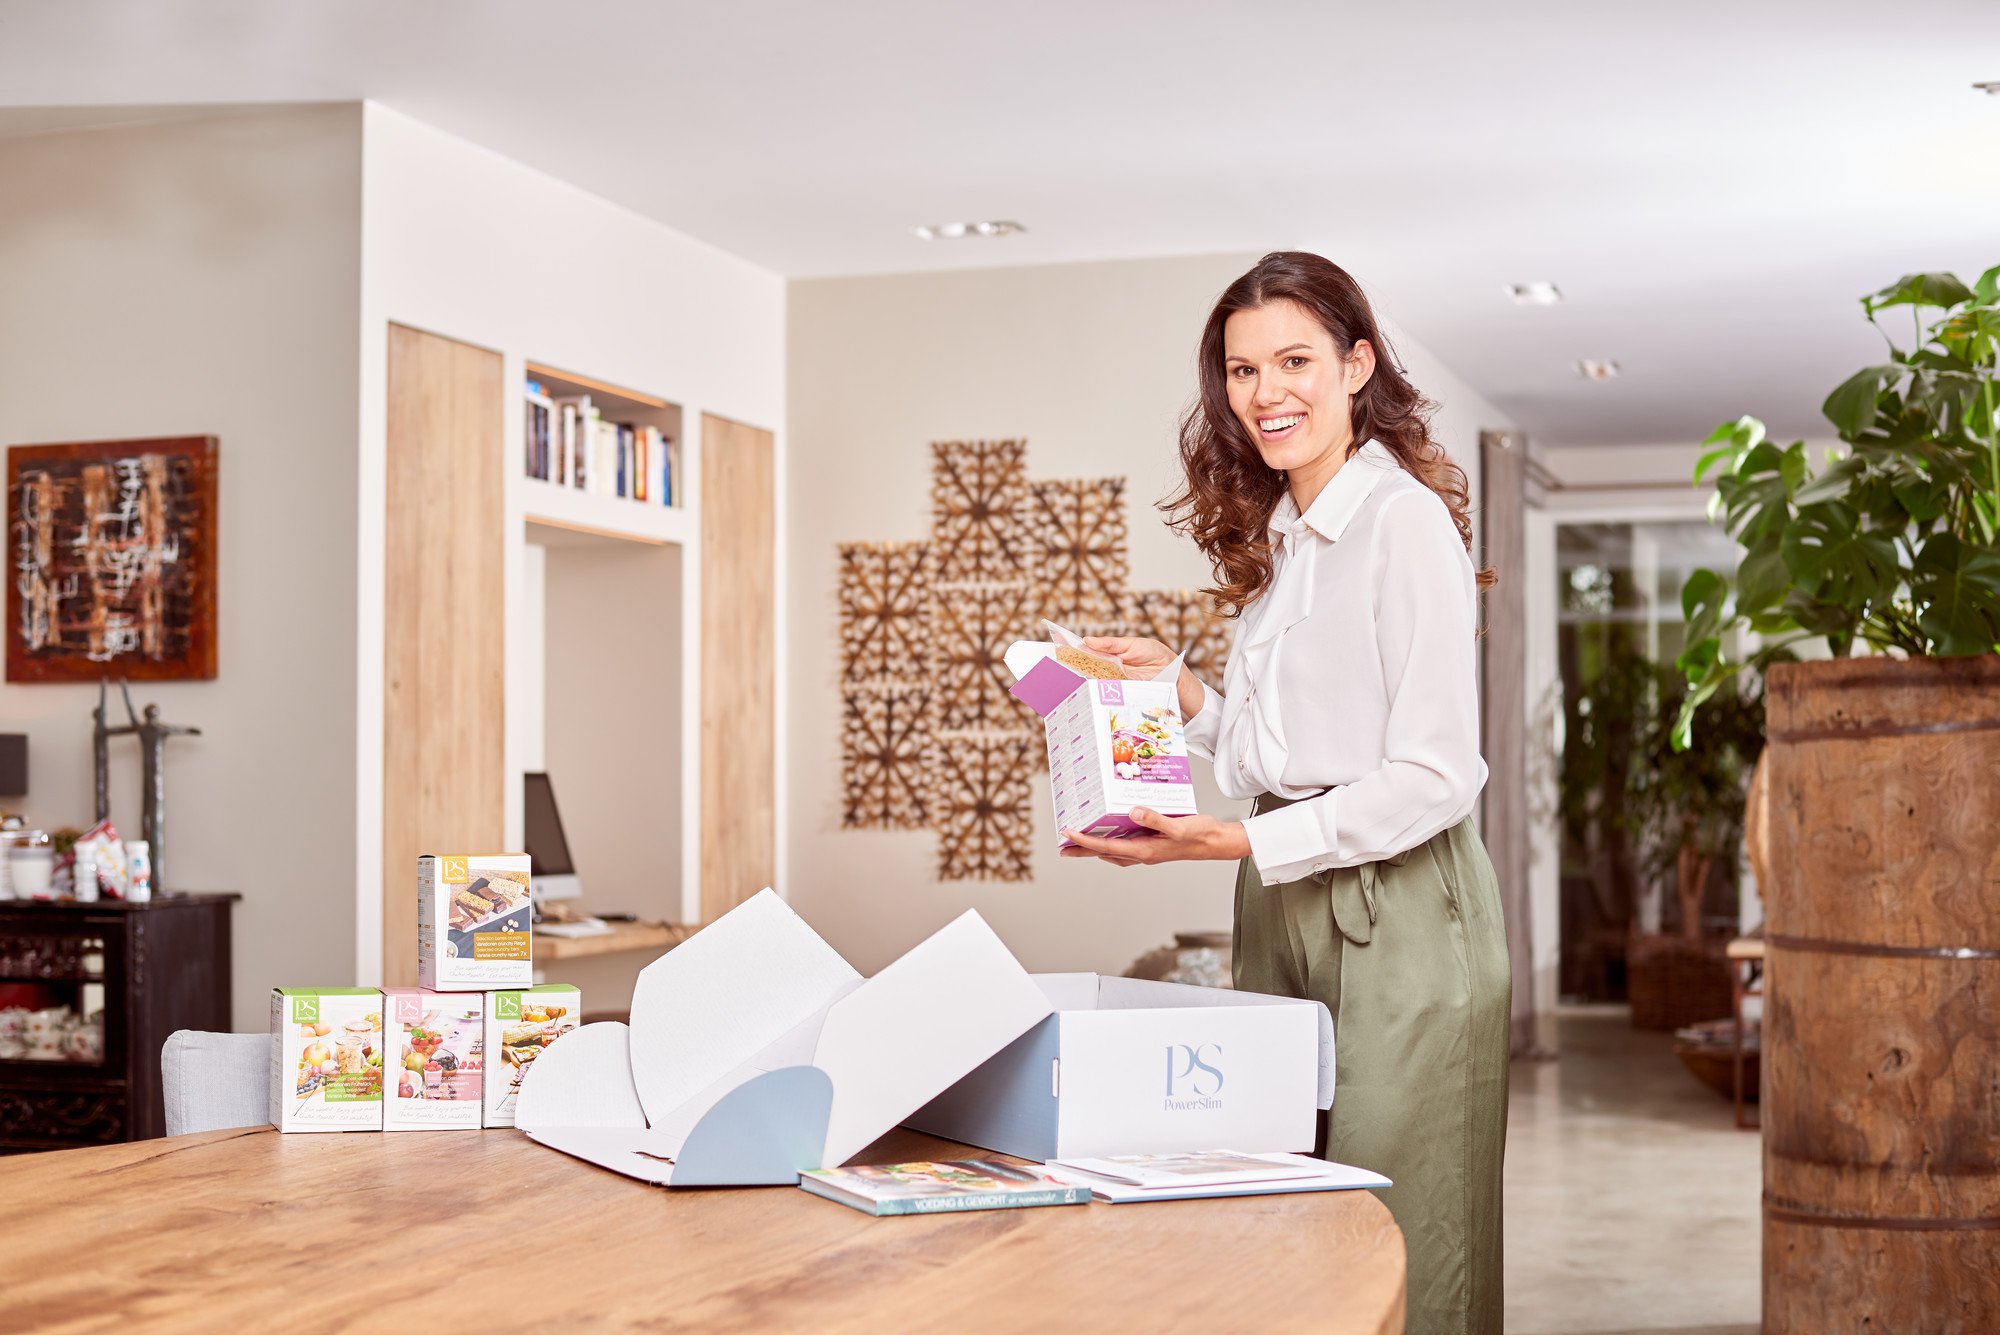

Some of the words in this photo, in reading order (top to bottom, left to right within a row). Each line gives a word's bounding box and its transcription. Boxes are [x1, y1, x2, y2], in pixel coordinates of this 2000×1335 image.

[1100, 682, 1121, 699] PS
[444, 860, 466, 878] PS
[295, 999, 317, 1017] PS
[398, 999, 419, 1016] PS
[498, 996, 518, 1014] PS
[1165, 1043, 1224, 1097] PS
[1164, 1096, 1223, 1112] PowerSlim
[914, 1197, 956, 1211] VOEDING
[957, 1197, 965, 1208] &
[965, 1195, 1007, 1208] GEWICHT
